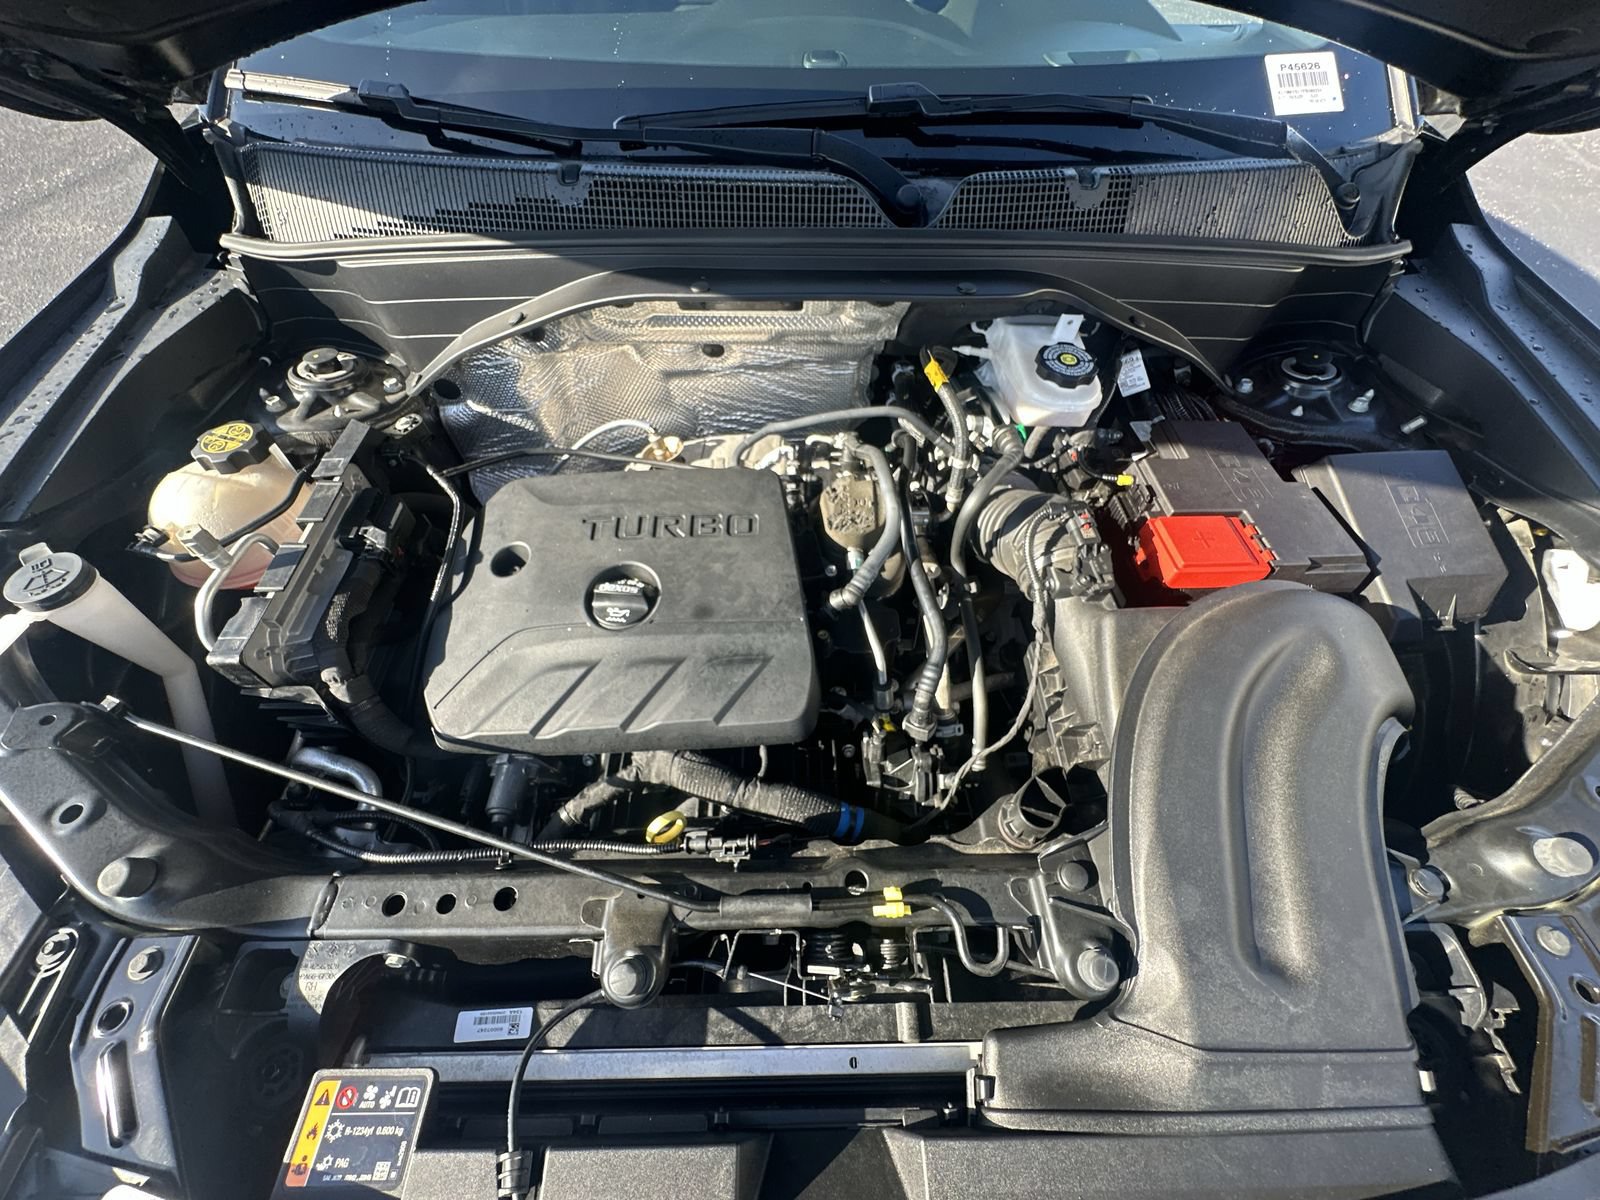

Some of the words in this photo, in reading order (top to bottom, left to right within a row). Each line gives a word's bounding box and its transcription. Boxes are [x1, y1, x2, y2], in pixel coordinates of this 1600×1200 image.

[582, 513, 760, 540] TURBO
[598, 582, 639, 594] dexos
[359, 1101, 376, 1109] AUTO
[344, 1126, 374, 1137] R-1234yf
[395, 1126, 404, 1137] kg
[334, 1158, 350, 1168] PAG
